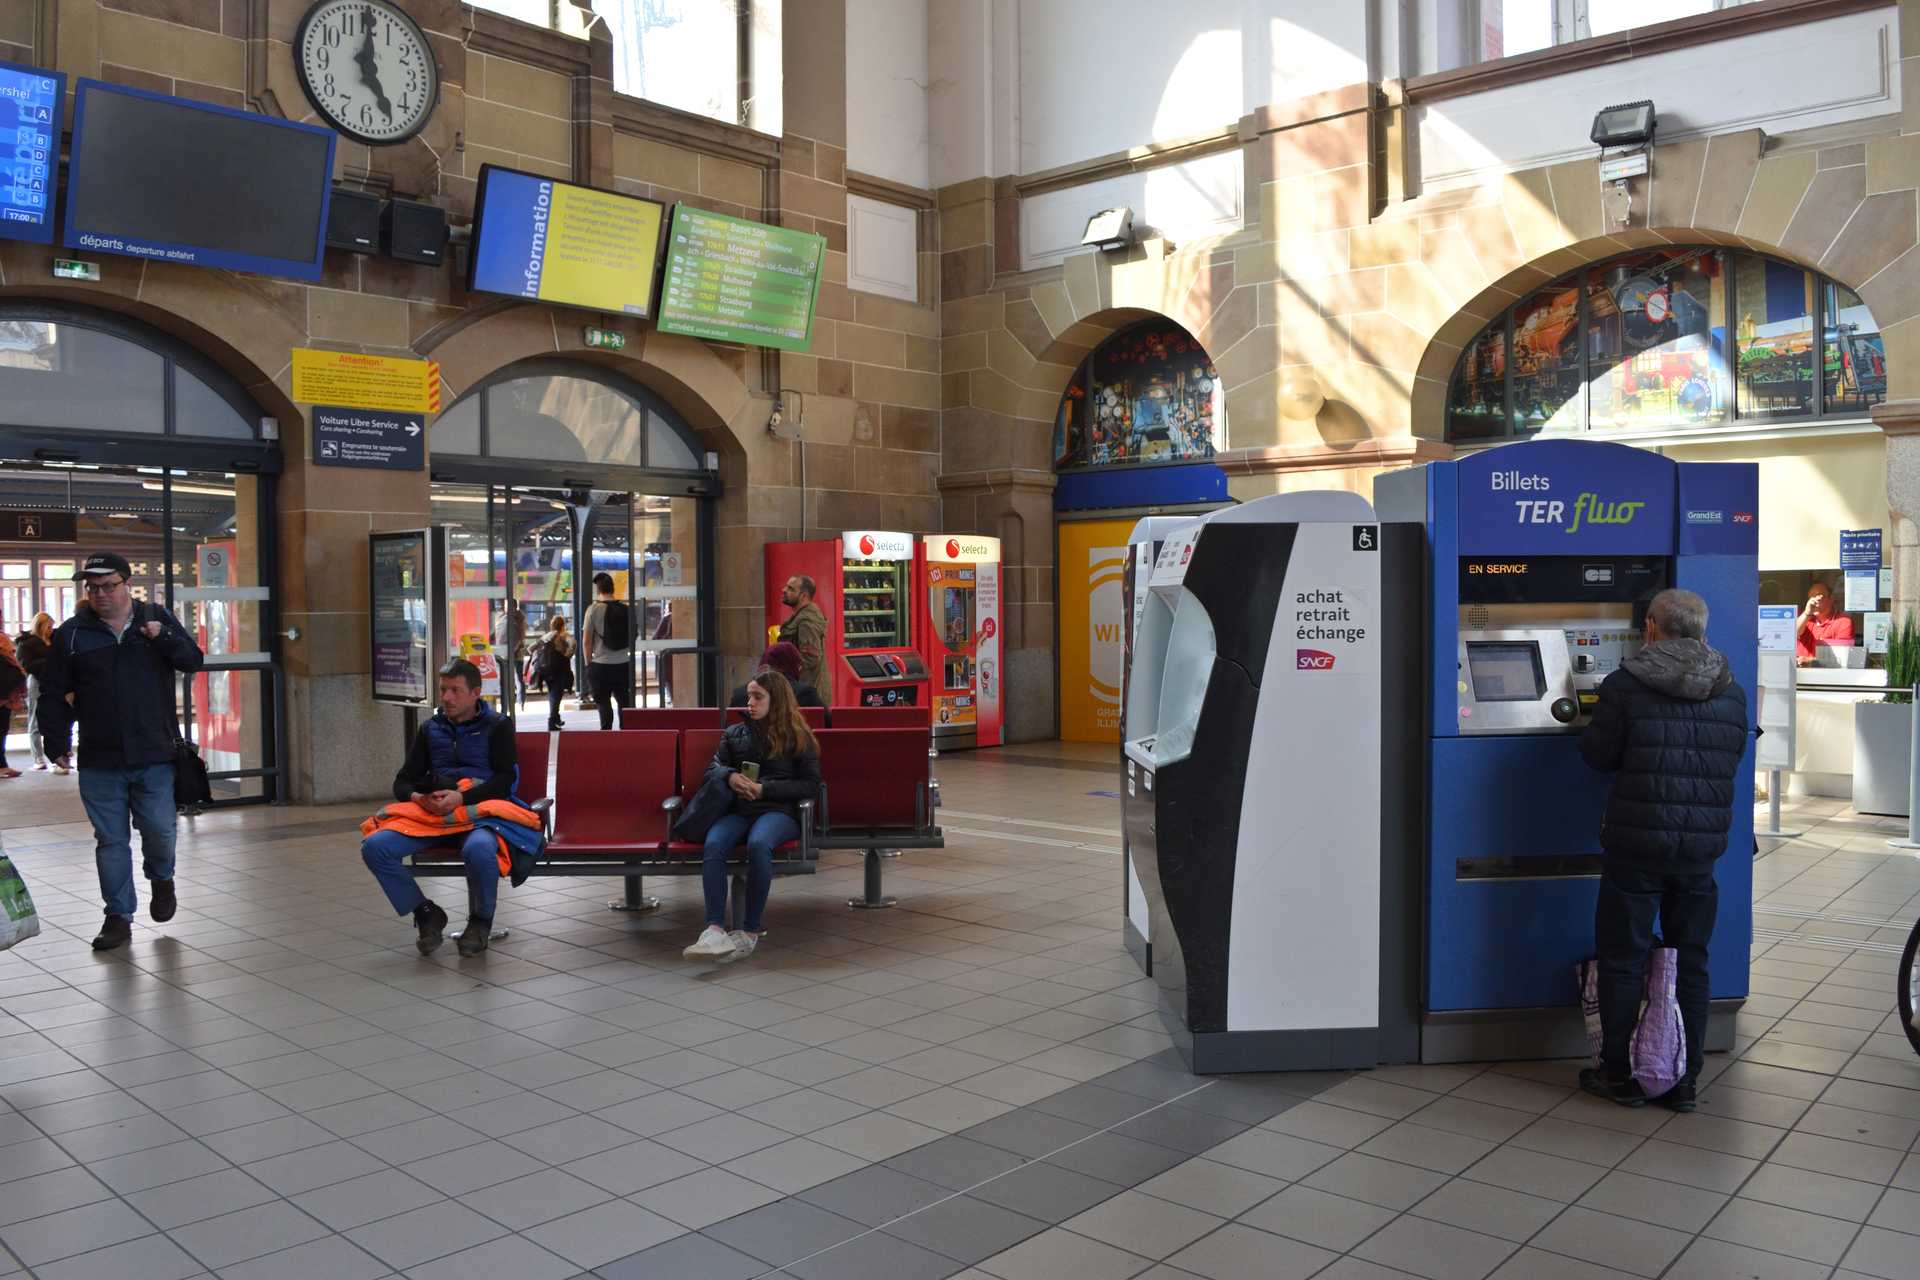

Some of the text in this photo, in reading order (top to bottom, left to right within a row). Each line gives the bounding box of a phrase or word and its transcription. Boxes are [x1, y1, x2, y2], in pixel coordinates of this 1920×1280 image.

[342, 12, 353, 36] 11
[322, 24, 340, 48] 10
[386, 23, 391, 46] 1
[317, 47, 329, 71] 9
[398, 43, 411, 66] 2
[42, 80, 50, 90] C
[324, 73, 335, 97] 8
[406, 69, 417, 92] 3
[340, 94, 351, 117] 7
[397, 92, 410, 114] 4
[38, 109, 47, 119] A
[361, 104, 373, 127] 6
[37, 137, 44, 145] B
[36, 151, 43, 159] D
[34, 166, 42, 174] C
[34, 180, 41, 189] A
[32, 195, 39, 203] B
[9, 212, 30, 221] 17:00
[80, 235, 124, 250] départs
[126, 244, 165, 257] departure
[521, 182, 551, 298] information
[320, 416, 399, 430] Voiture Libre Service
[1491, 471, 1550, 490] Billets
[1515, 492, 1645, 533] TER fluo
[1687, 511, 1752, 523] Grand Est SNCF
[25, 525, 35, 536] A
[876, 541, 905, 552] selecta
[961, 544, 988, 555] selecta
[1468, 565, 1528, 574] EN SERVICE
[1296, 589, 1343, 603] achat
[1296, 607, 1350, 621] retrait
[1094, 624, 1120, 641] WI
[1296, 625, 1365, 643] échange
[1298, 656, 1334, 668] SNCF
